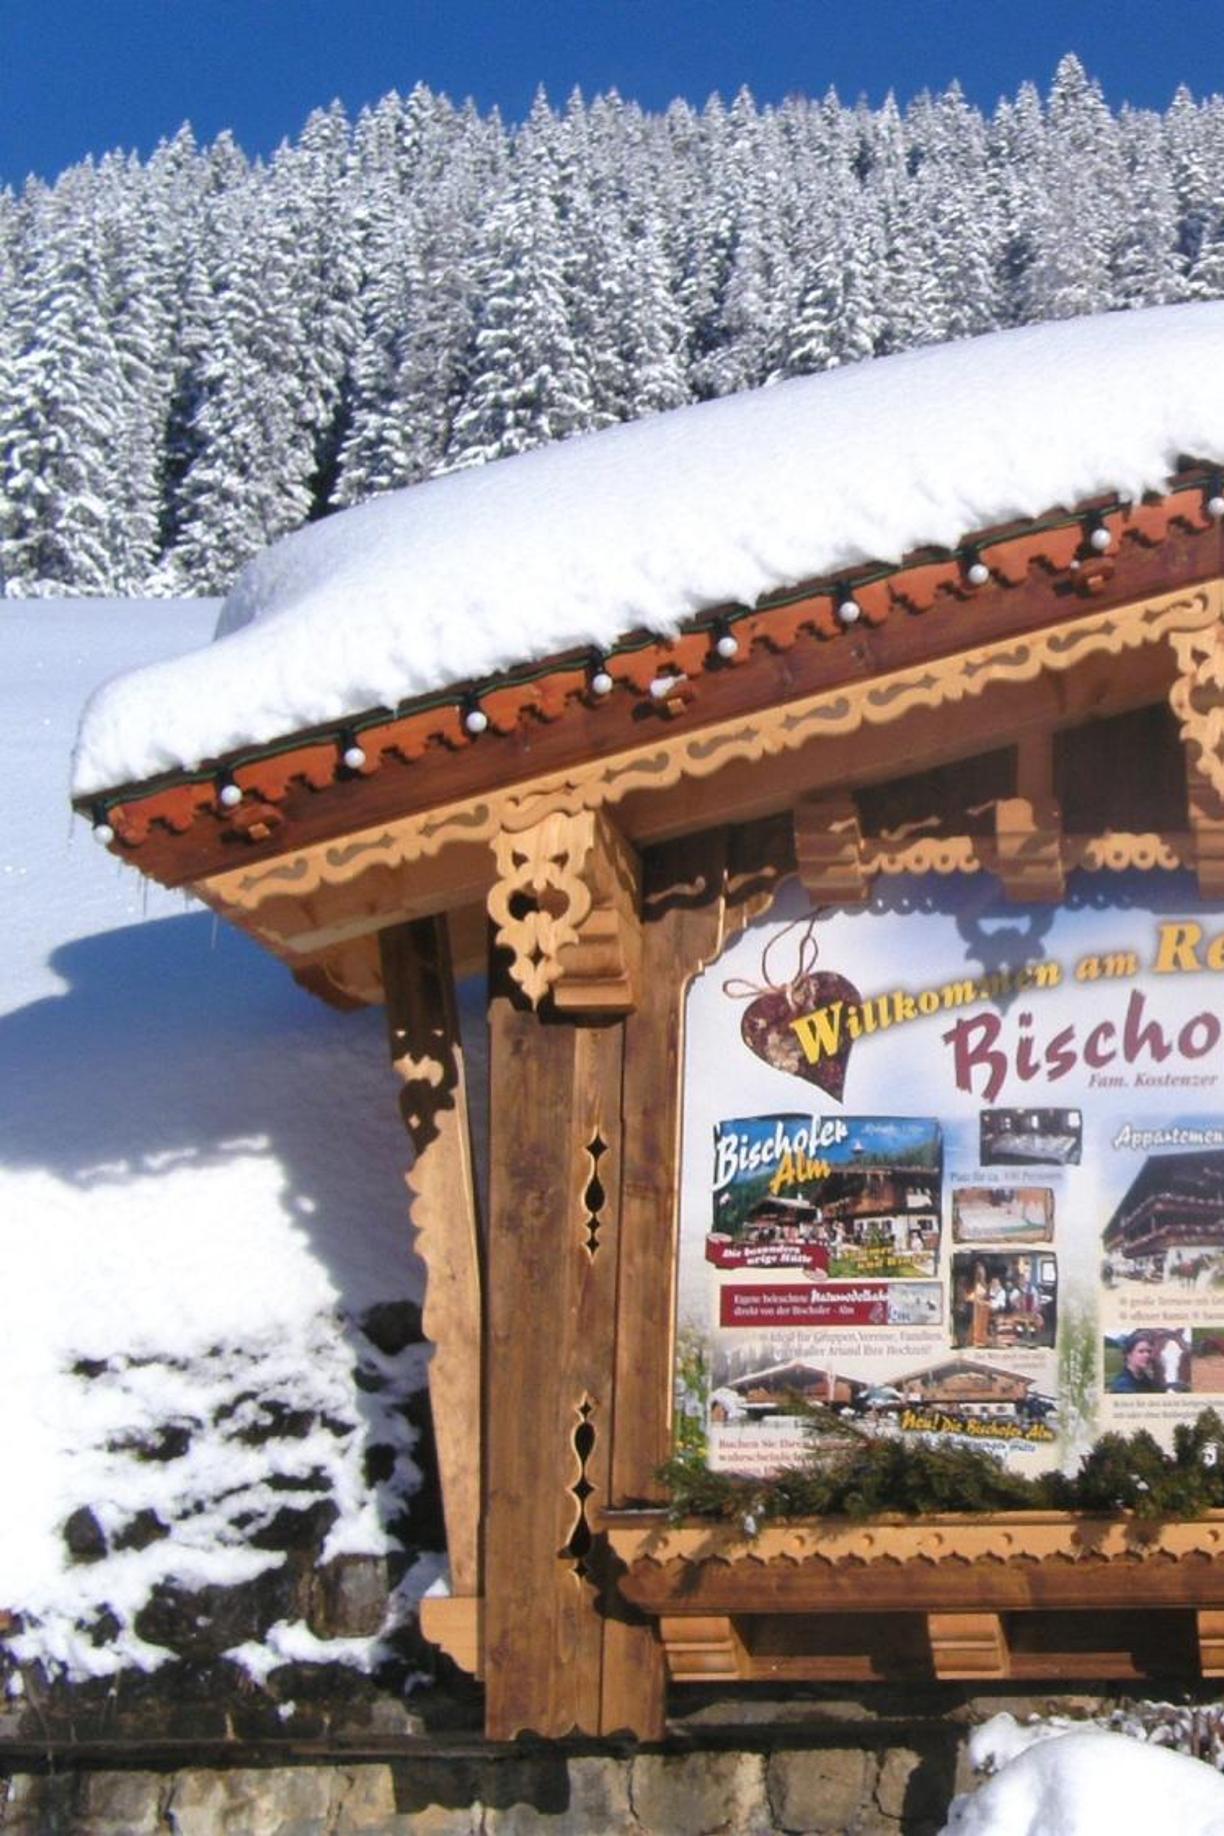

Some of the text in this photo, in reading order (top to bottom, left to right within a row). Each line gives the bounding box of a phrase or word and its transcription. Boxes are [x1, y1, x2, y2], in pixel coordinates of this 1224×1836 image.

[789, 962, 1061, 1065] Willkommen
[1075, 952, 1139, 979] am
[1087, 1071, 1219, 1089] Fam. Kostenzer
[712, 1115, 849, 1192] Bischofer
[770, 1149, 833, 1196] Alm
